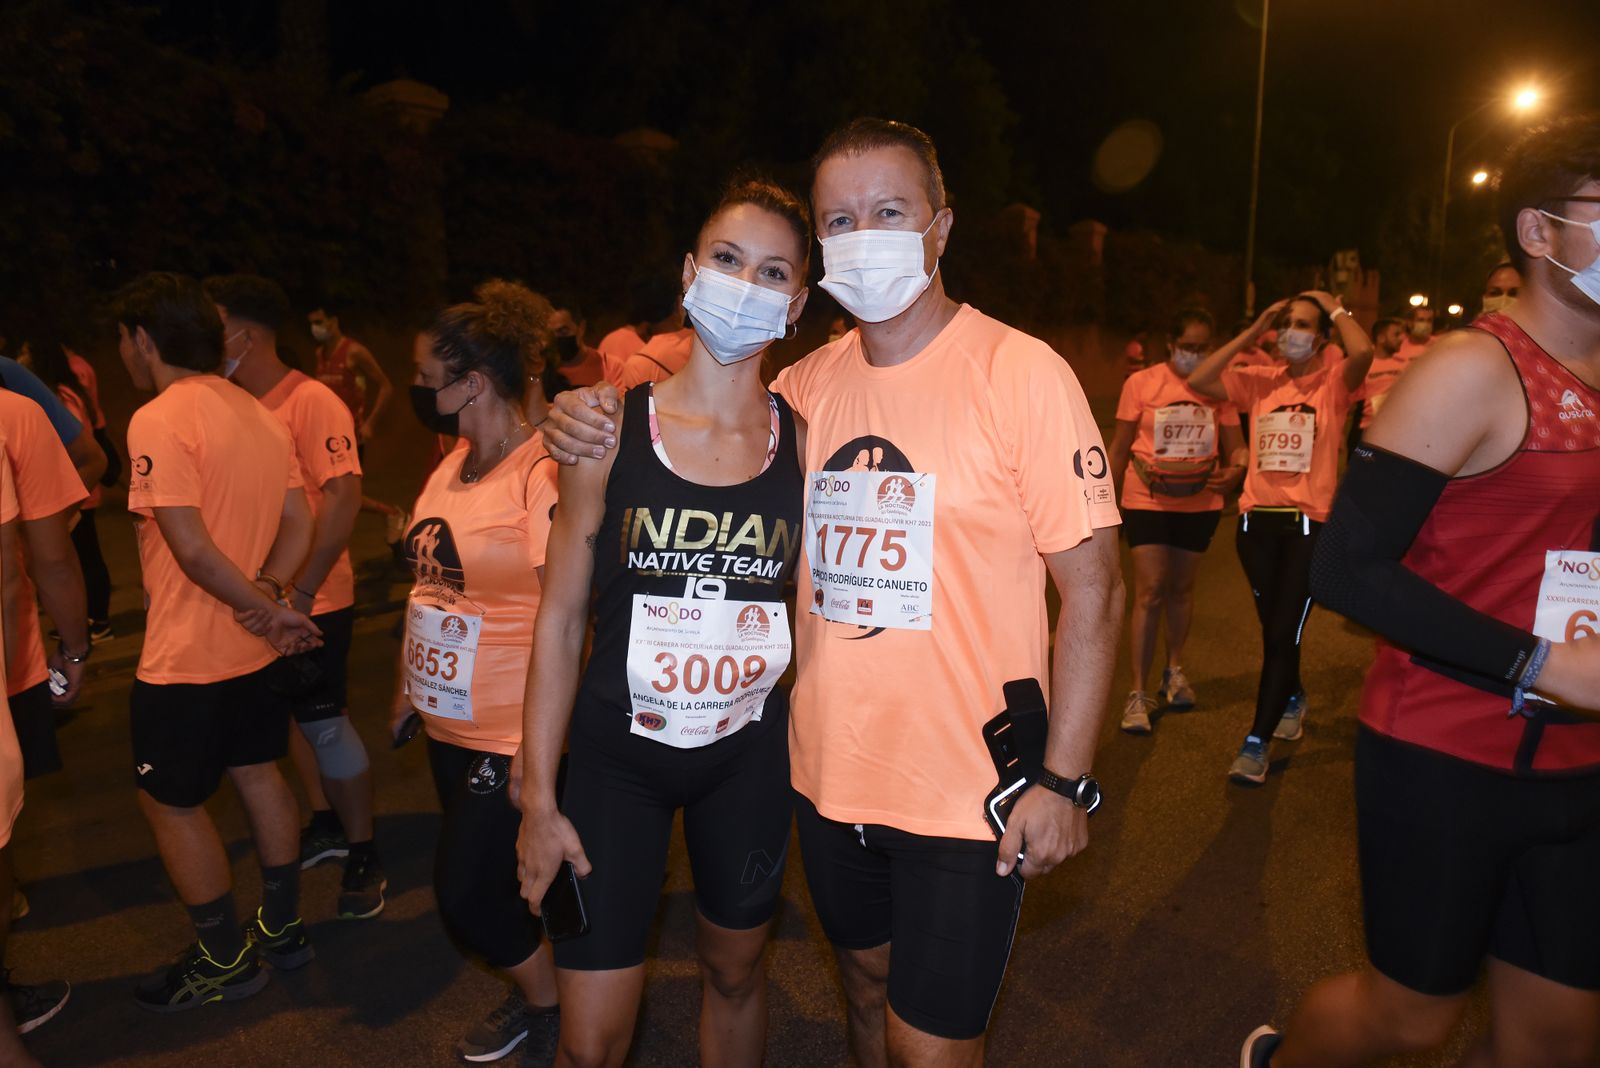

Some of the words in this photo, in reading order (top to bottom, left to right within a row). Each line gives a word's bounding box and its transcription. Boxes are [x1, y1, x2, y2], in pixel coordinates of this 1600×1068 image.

[1163, 424, 1206, 439] 6777
[1259, 433, 1302, 450] 6799
[619, 507, 799, 572] INDIAN
[816, 523, 907, 572] 1775
[628, 551, 715, 573] NATIVE
[721, 555, 783, 579] TEAM
[829, 572, 874, 588] RODRÍGUEZ
[877, 578, 928, 592] CANUETO
[1567, 597, 1599, 606] CARRERA
[653, 640, 679, 648] CARRERA
[408, 637, 459, 681] 6653
[651, 651, 767, 695] 3009
[632, 692, 665, 706] ANGELA
[666, 700, 678, 710] DE
[680, 702, 692, 710] LA
[694, 699, 734, 710] CARRERA
